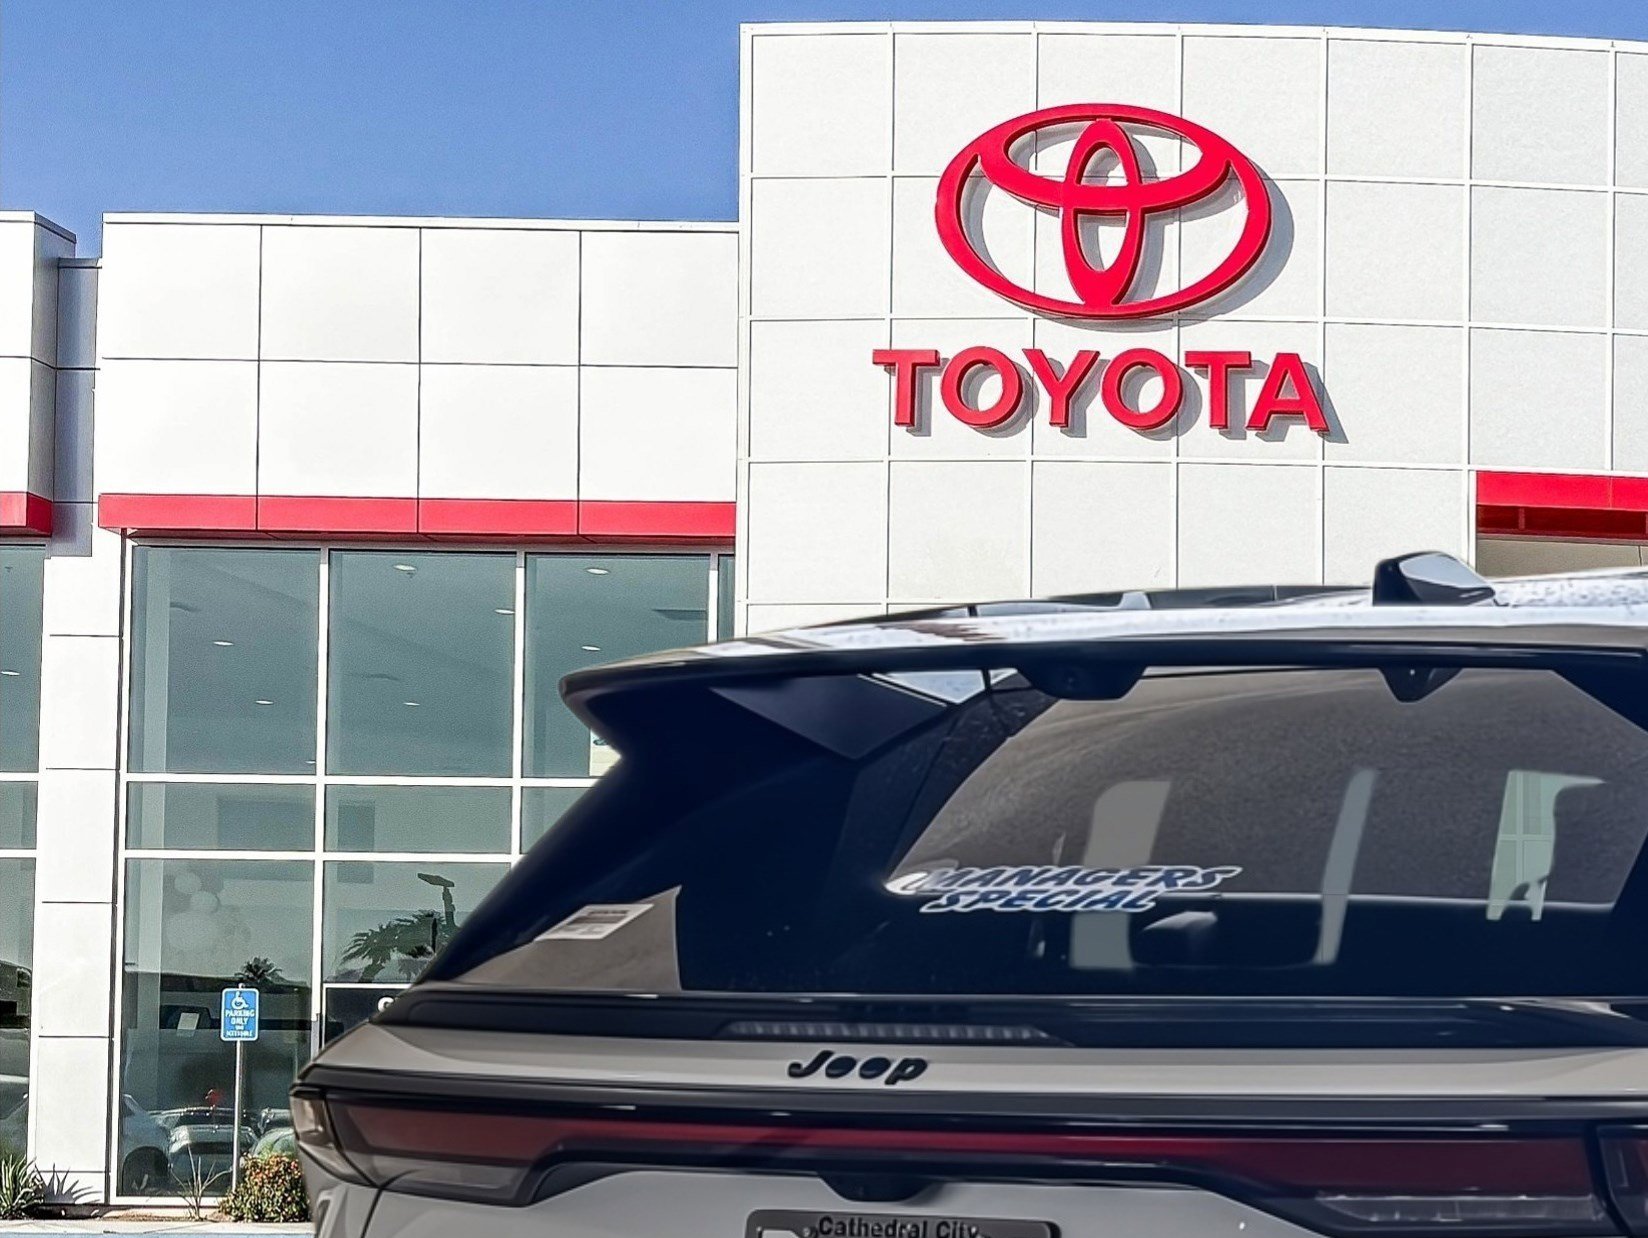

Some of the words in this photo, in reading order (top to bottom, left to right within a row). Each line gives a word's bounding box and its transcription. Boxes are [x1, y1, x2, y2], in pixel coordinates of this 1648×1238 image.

[873, 346, 1330, 433] TOYOTA
[922, 889, 1155, 912] SPECIAL
[787, 1050, 928, 1086] Jeep
